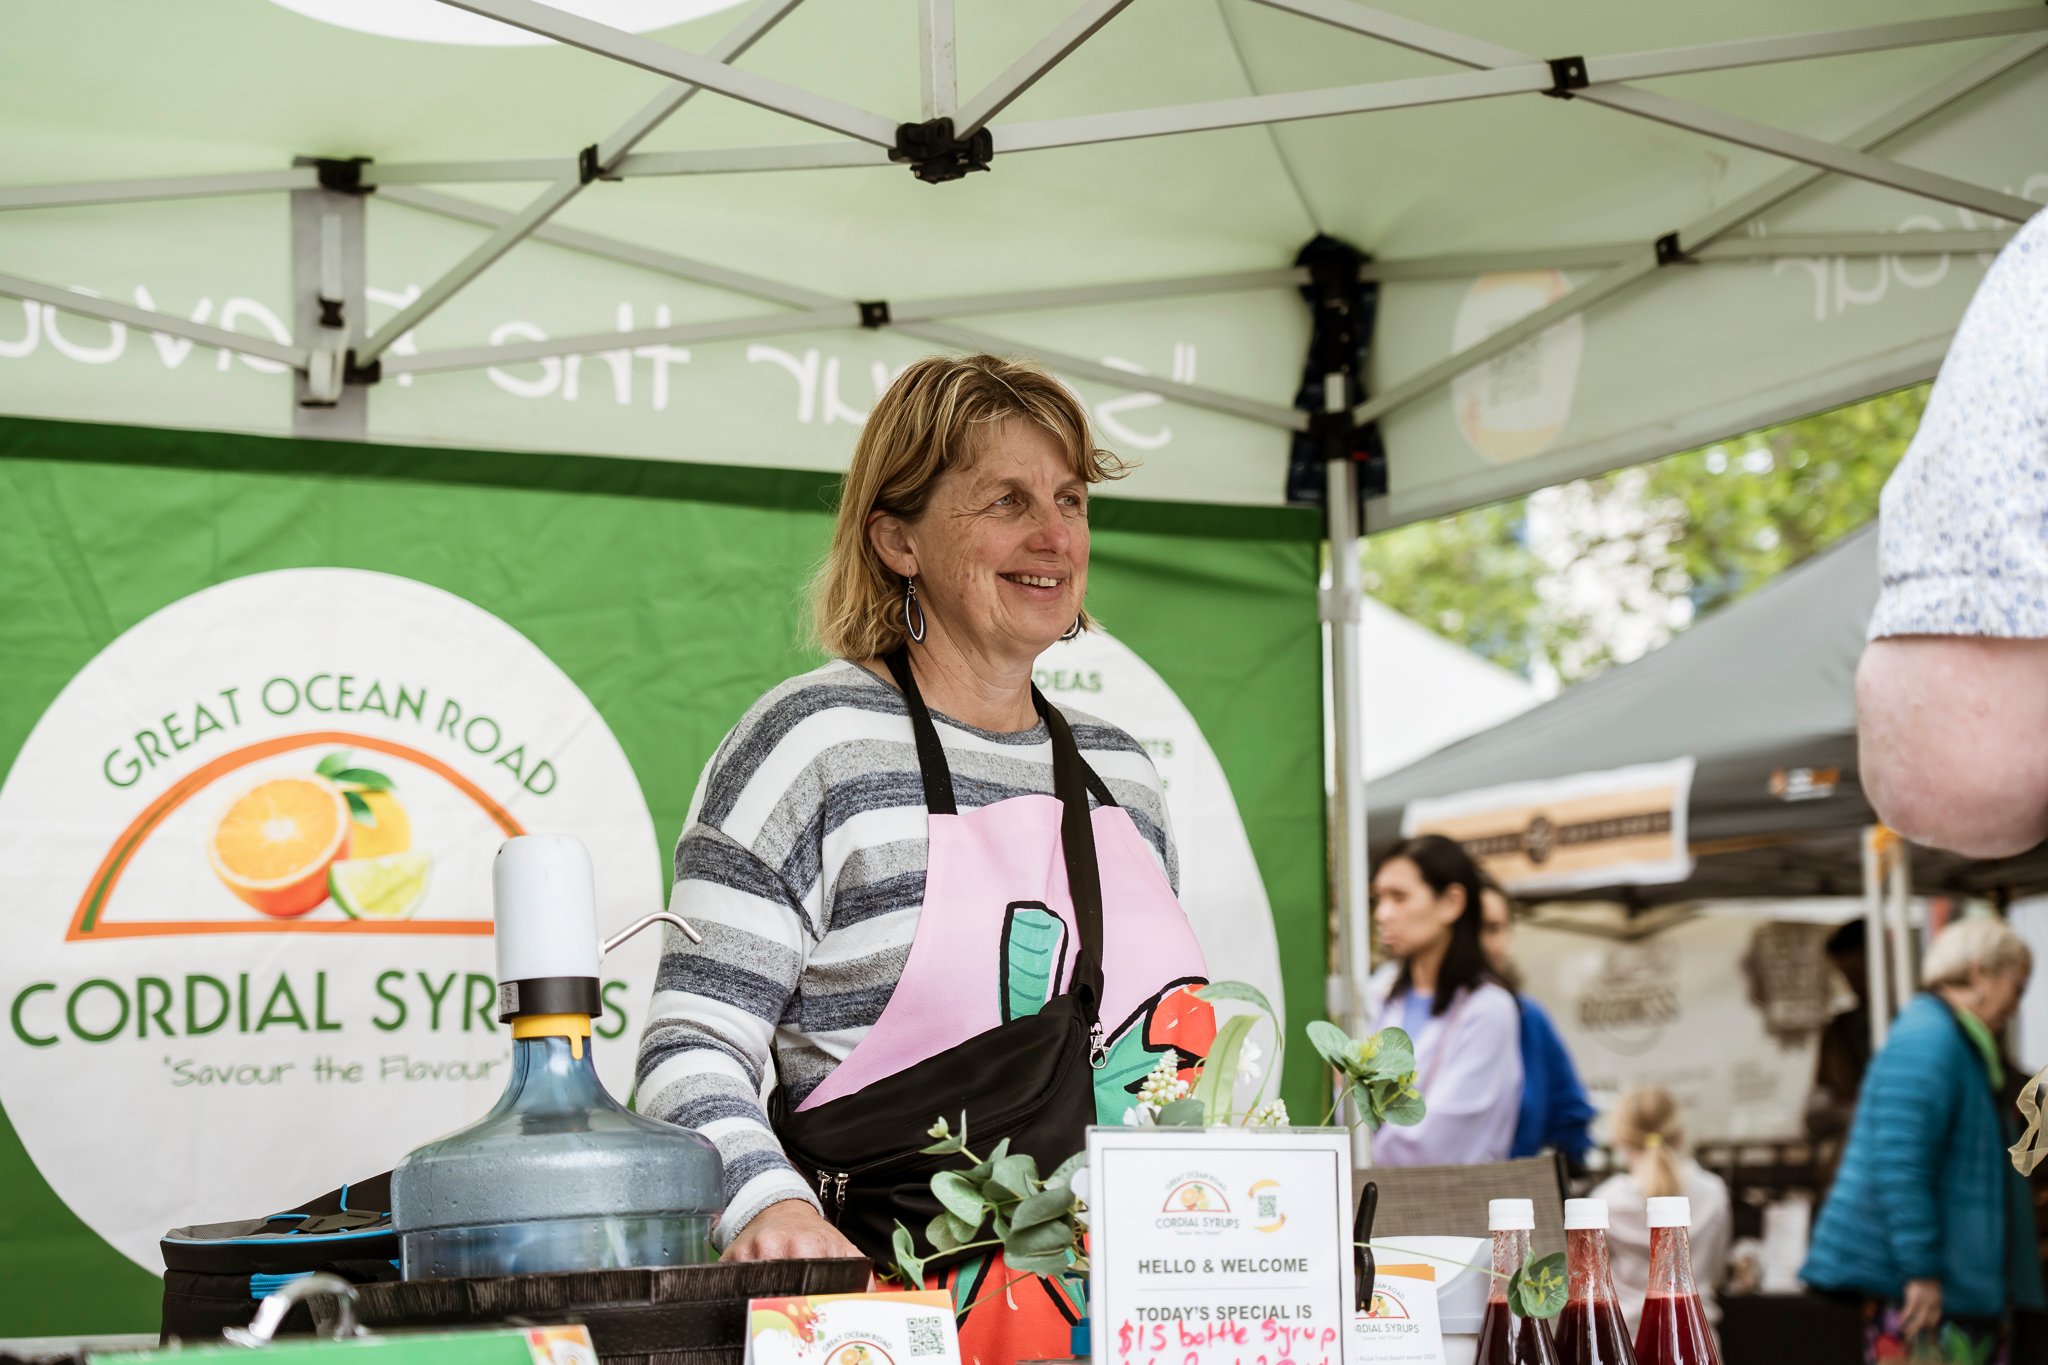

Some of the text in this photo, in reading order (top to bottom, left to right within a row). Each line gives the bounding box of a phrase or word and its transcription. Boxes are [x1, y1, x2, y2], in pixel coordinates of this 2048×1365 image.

[1032, 668, 1103, 693] DEAS
[103, 674, 558, 796] GREAT OCEAN ROAD
[10, 969, 628, 1048] CORDIAL SYRS
[312, 1056, 365, 1083] the
[1155, 1217, 1240, 1229] CORDIAL SYRUPS
[1138, 1258, 1308, 1273] HELLO & WELCOME
[1136, 1304, 1312, 1321] TODAY'S SPECIAL IS
[1118, 1319, 1167, 1357] $15
[1178, 1319, 1249, 1348] bottle
[1355, 1323, 1420, 1334] RDIAL SYRUPS
